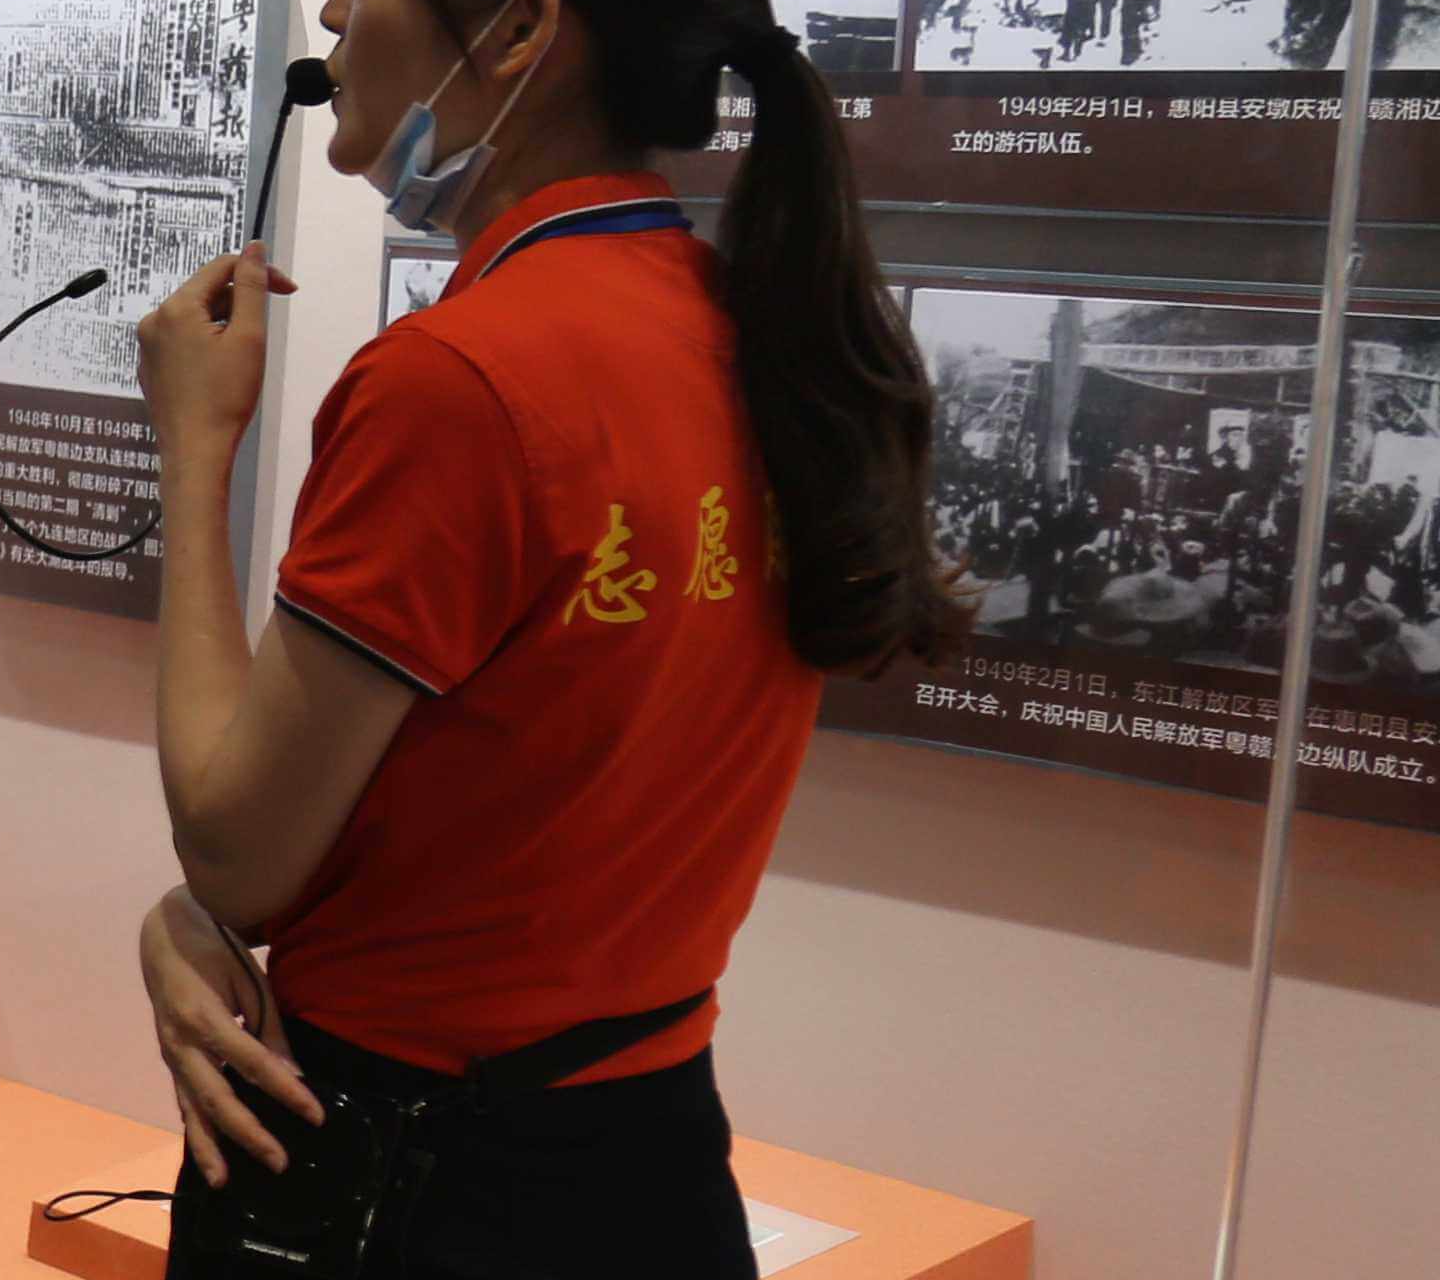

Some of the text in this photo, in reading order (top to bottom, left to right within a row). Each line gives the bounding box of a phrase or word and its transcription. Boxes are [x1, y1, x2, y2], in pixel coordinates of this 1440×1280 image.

[997, 93, 1440, 120] 1949年2月1日，惠阳县安墩庆祝赣湘边
[950, 130, 1096, 155] 立的游行队伍。
[7, 407, 158, 443] 1948年10月至1949年1
[914, 682, 1438, 785] 召开大会，庆祝中国人民解放军粤赣边纵队成立。
